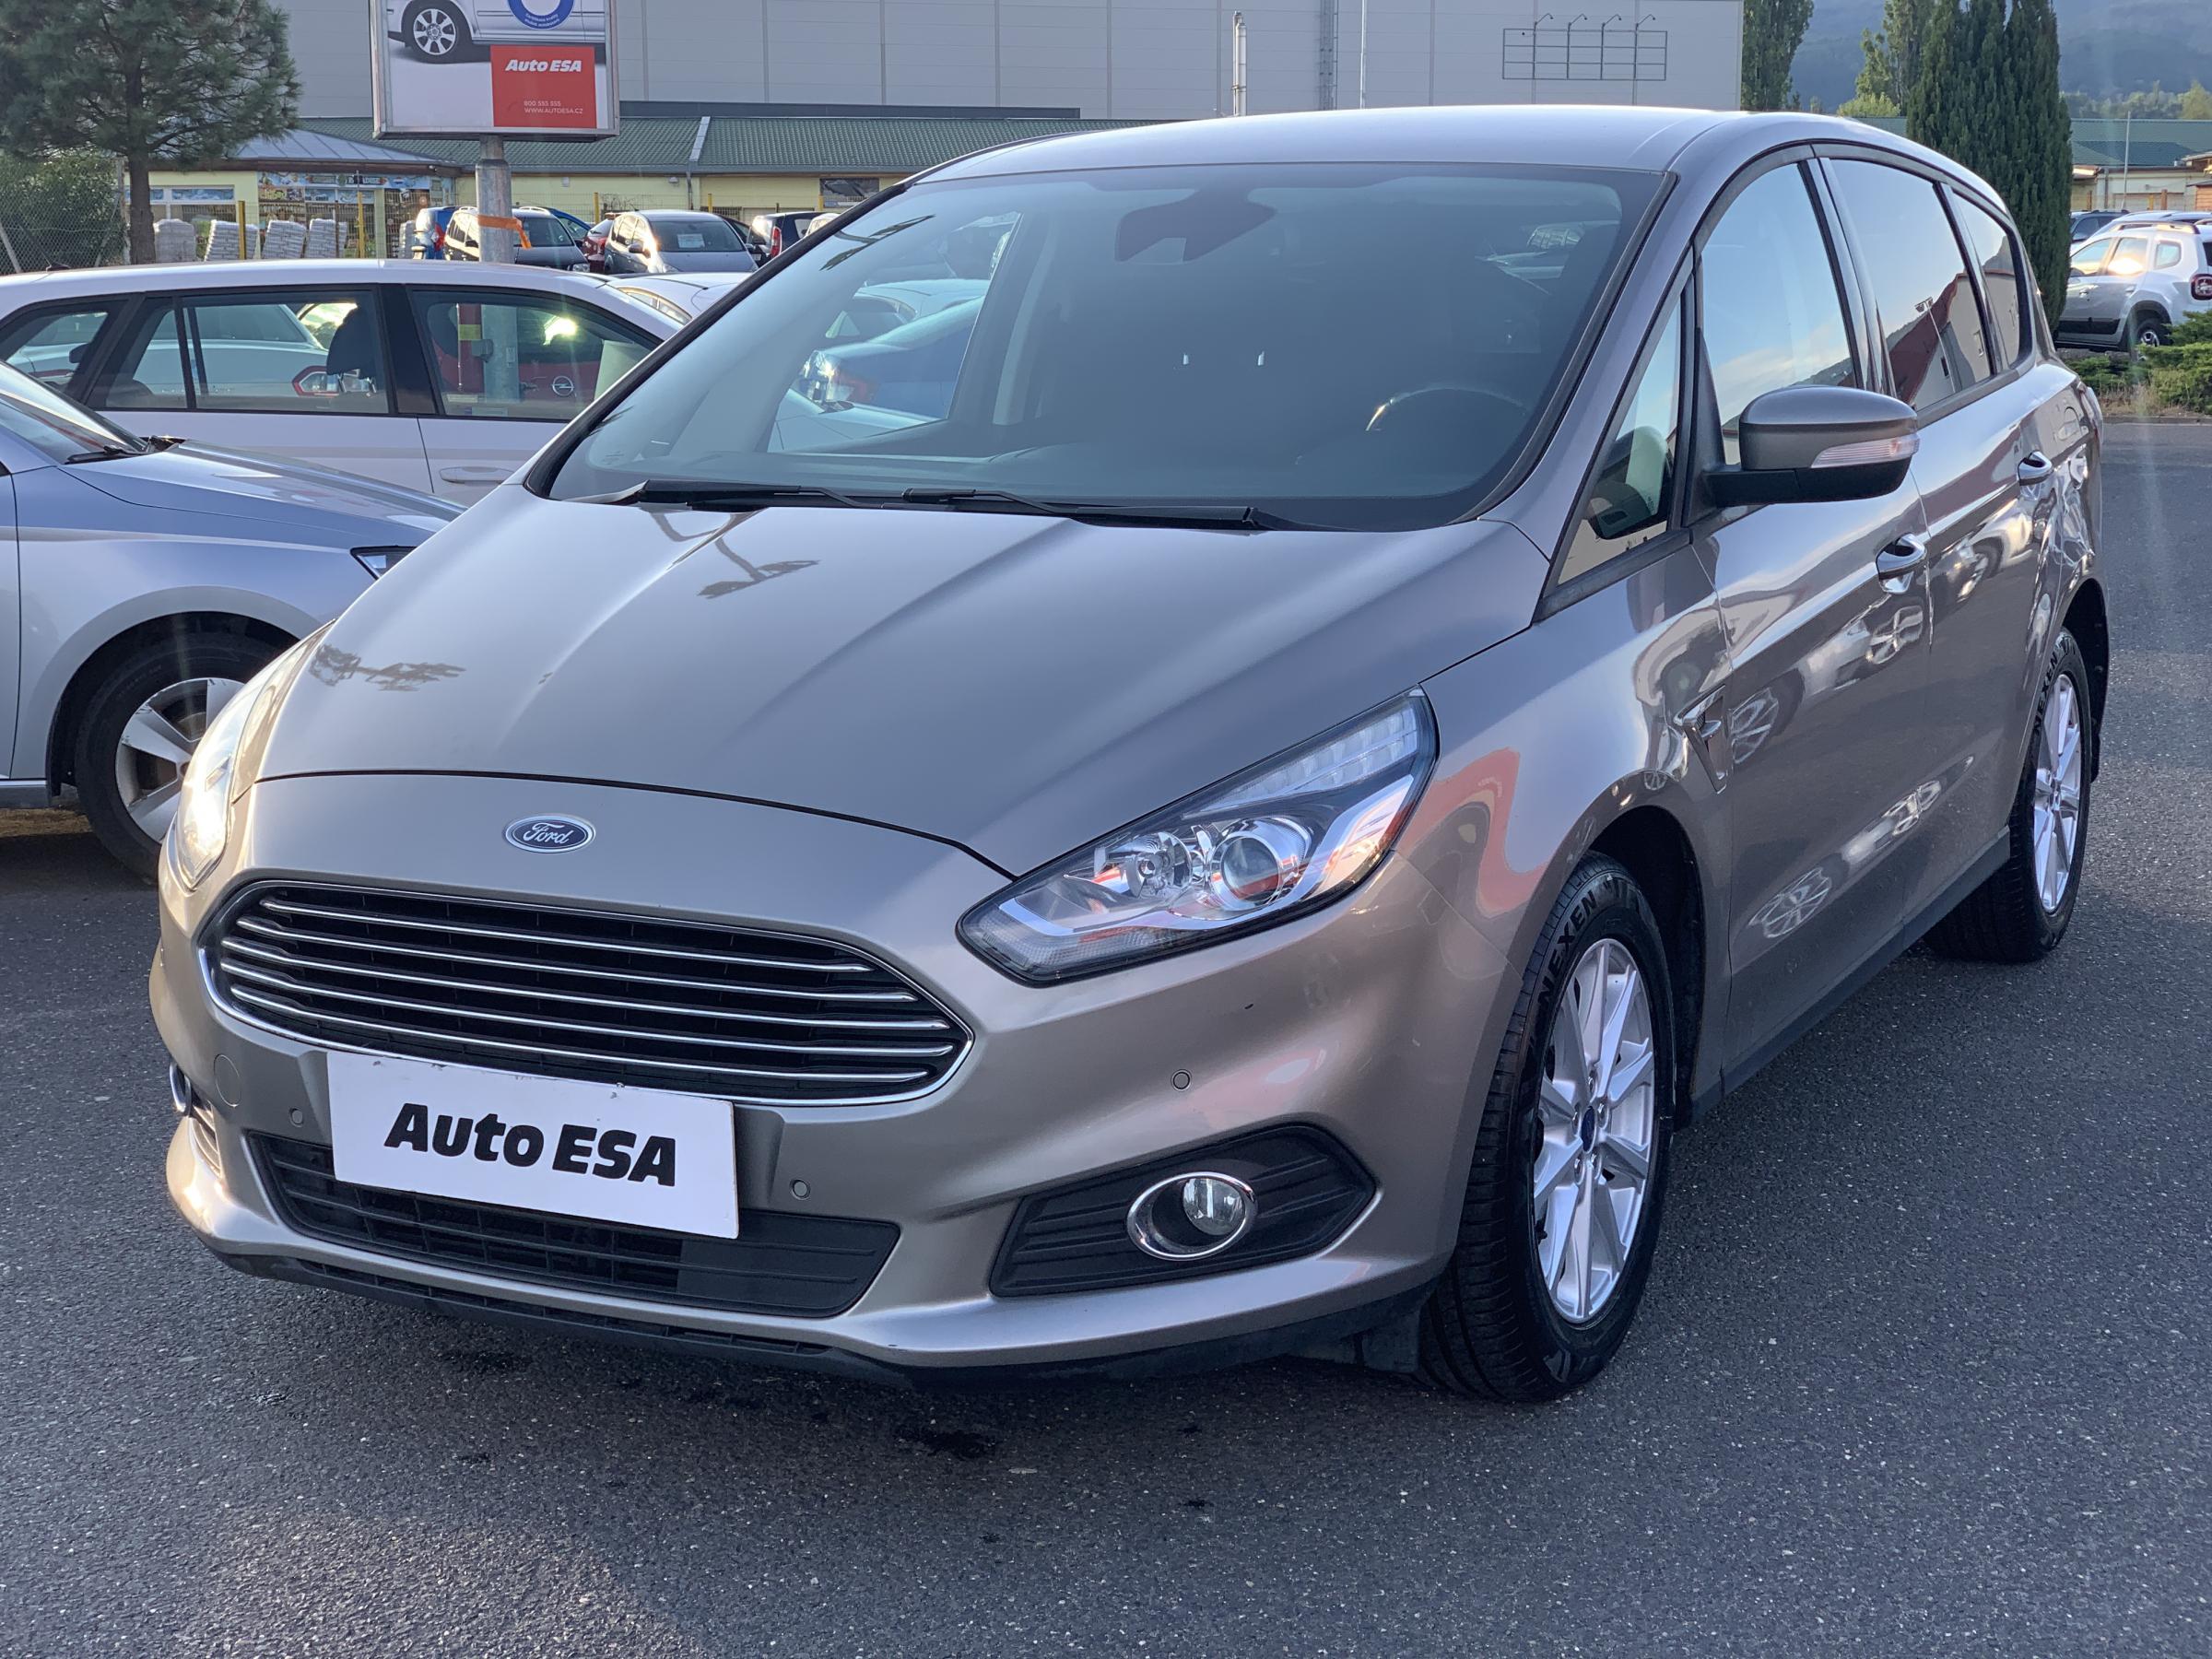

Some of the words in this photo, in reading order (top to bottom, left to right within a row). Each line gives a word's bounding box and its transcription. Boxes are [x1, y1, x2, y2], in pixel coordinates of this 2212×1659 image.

[505, 59, 548, 72] Auto
[549, 59, 582, 72] ESA
[523, 822, 574, 844] Ford
[1537, 889, 1597, 1010] NEXEN
[383, 1102, 544, 1168] Auto
[552, 1124, 677, 1187] ESA
